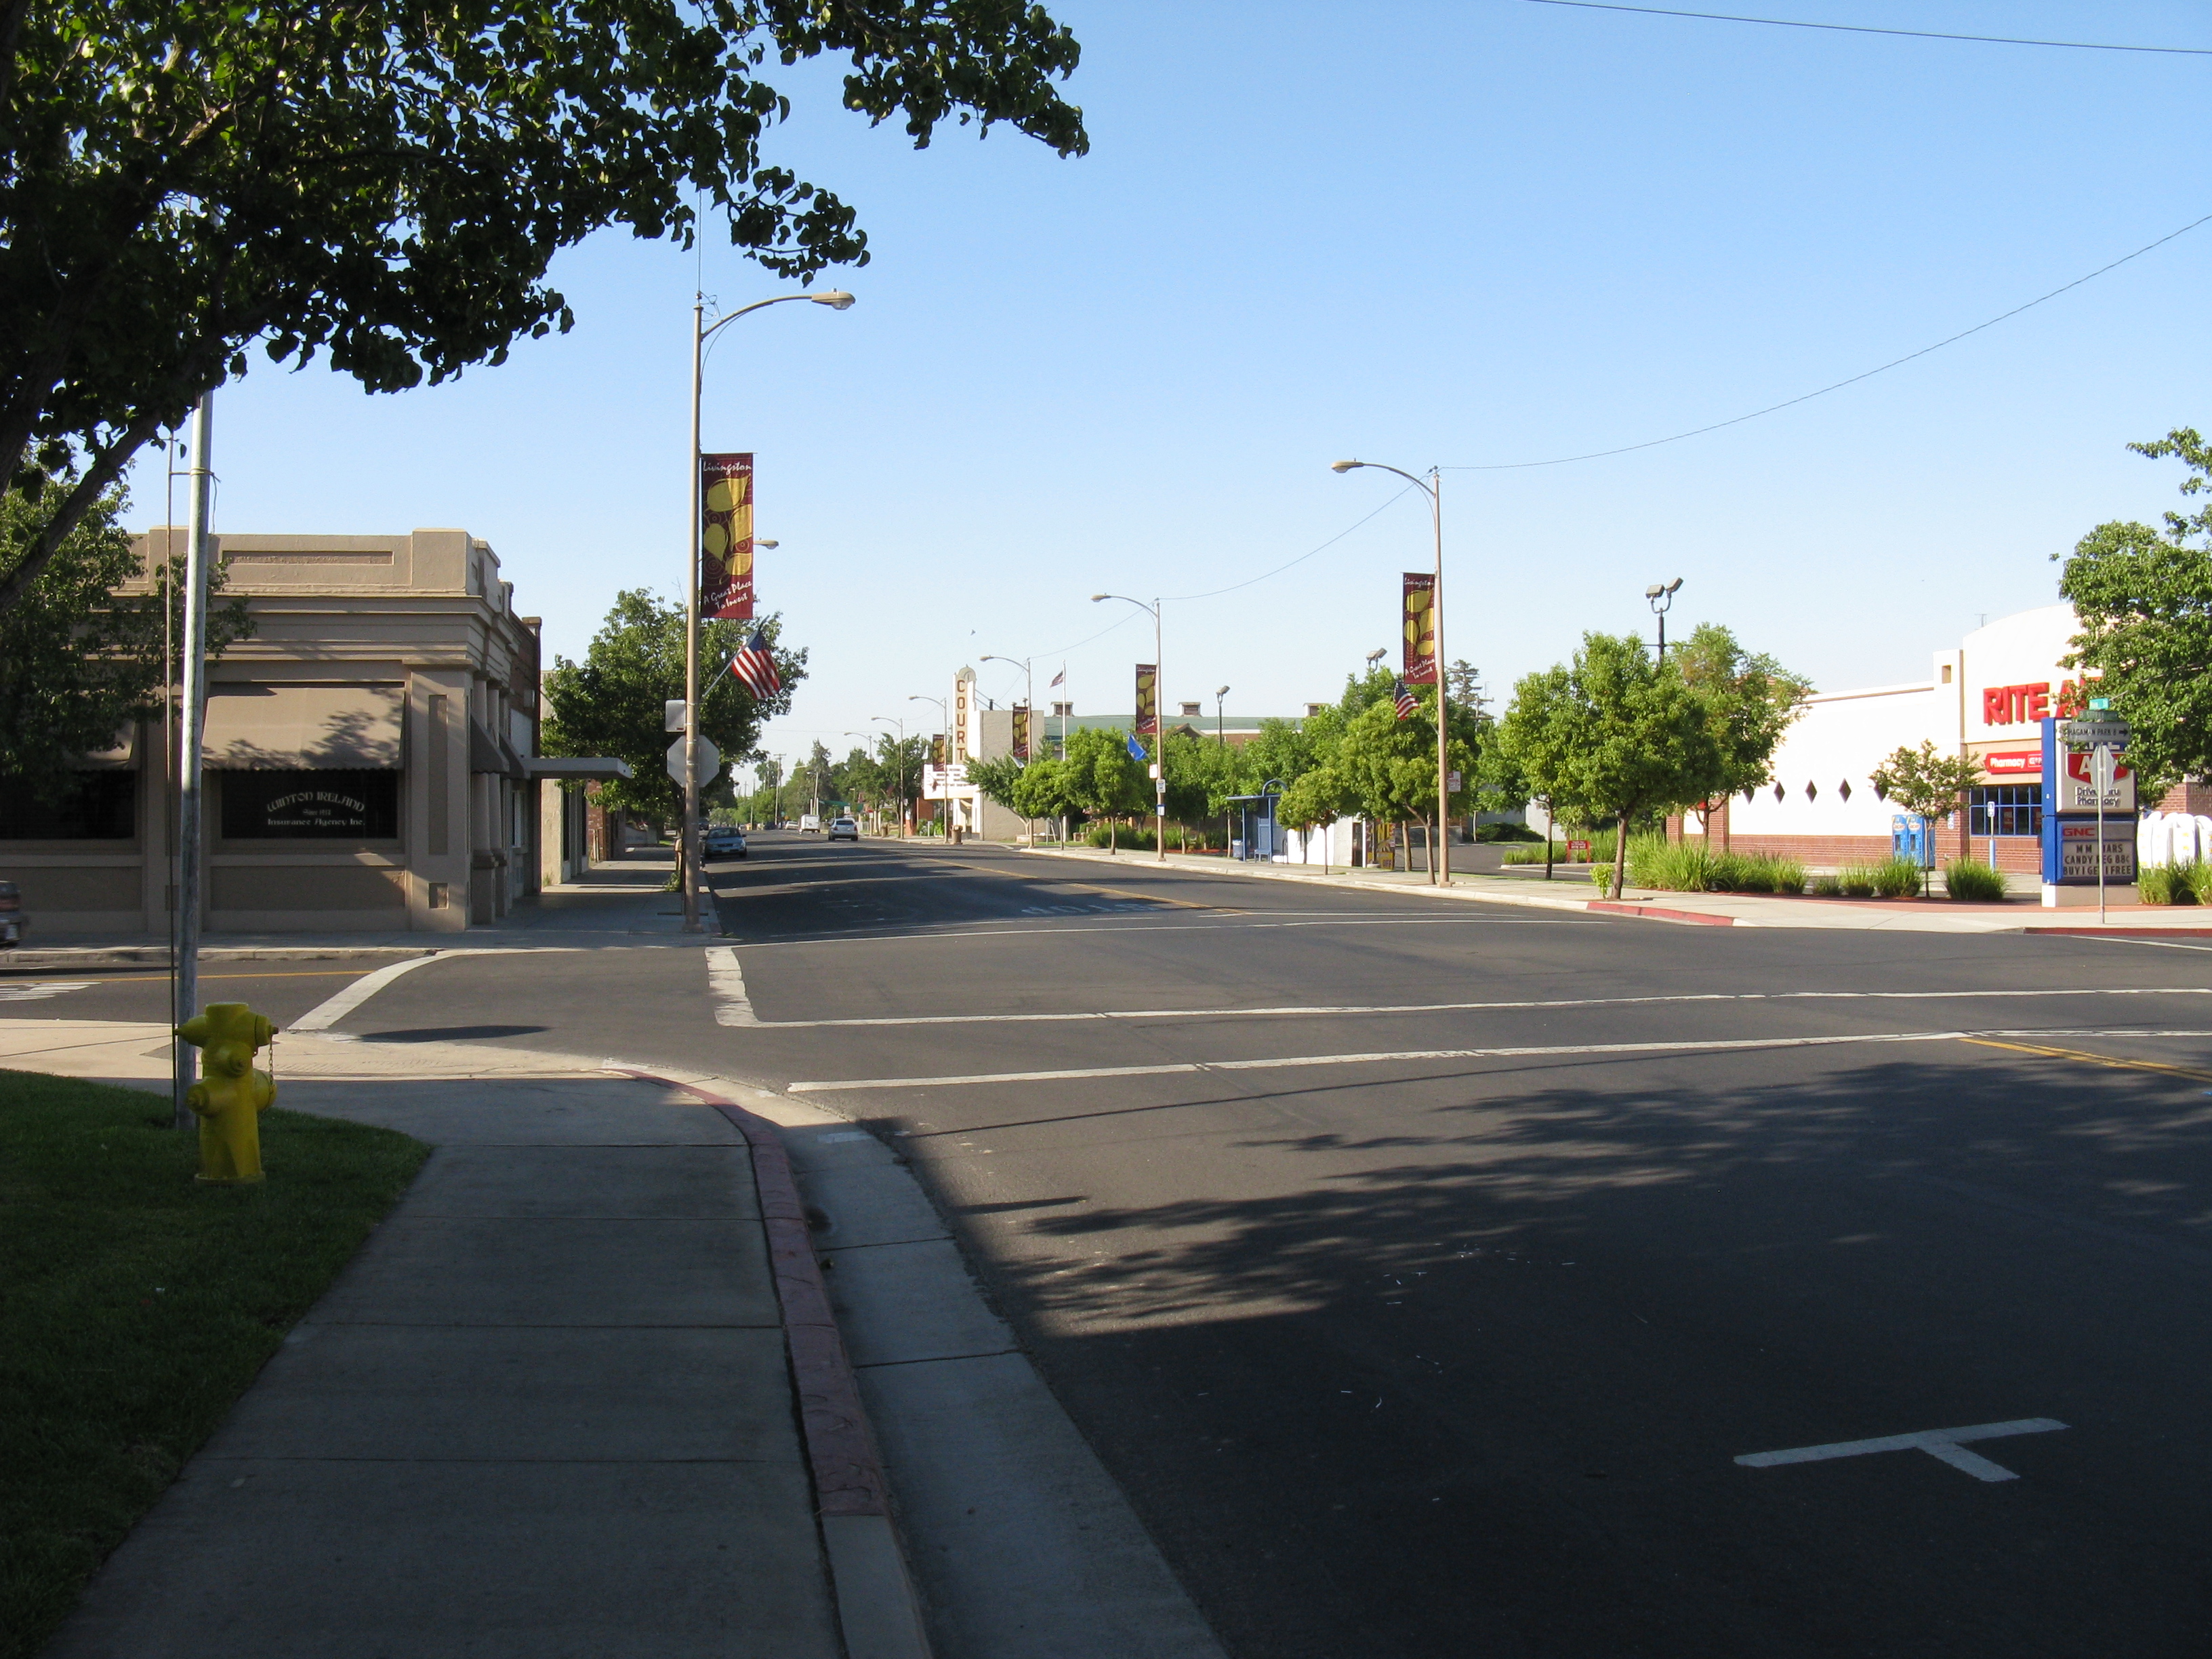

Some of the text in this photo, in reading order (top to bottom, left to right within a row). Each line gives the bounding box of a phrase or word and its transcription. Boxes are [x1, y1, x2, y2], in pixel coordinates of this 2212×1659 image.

[703, 462, 752, 475] Livingston
[703, 581, 752, 605] A Great Place
[715, 592, 748, 610] To Invest
[1983, 682, 2050, 726] RITE
[956, 680, 966, 760] COURT
[1990, 757, 2026, 769] Pharmacy
[316, 791, 365, 812] IRELAND
[2075, 796, 2119, 806] Pharacy
[268, 818, 365, 827] Insurance Agency Inc.
[2063, 827, 2095, 837] GNC
[2064, 855, 2093, 864] CANDY
[2063, 866, 2079, 876] BUY
[2087, 866, 2099, 875] GE
[2110, 865, 2131, 875] FREE
